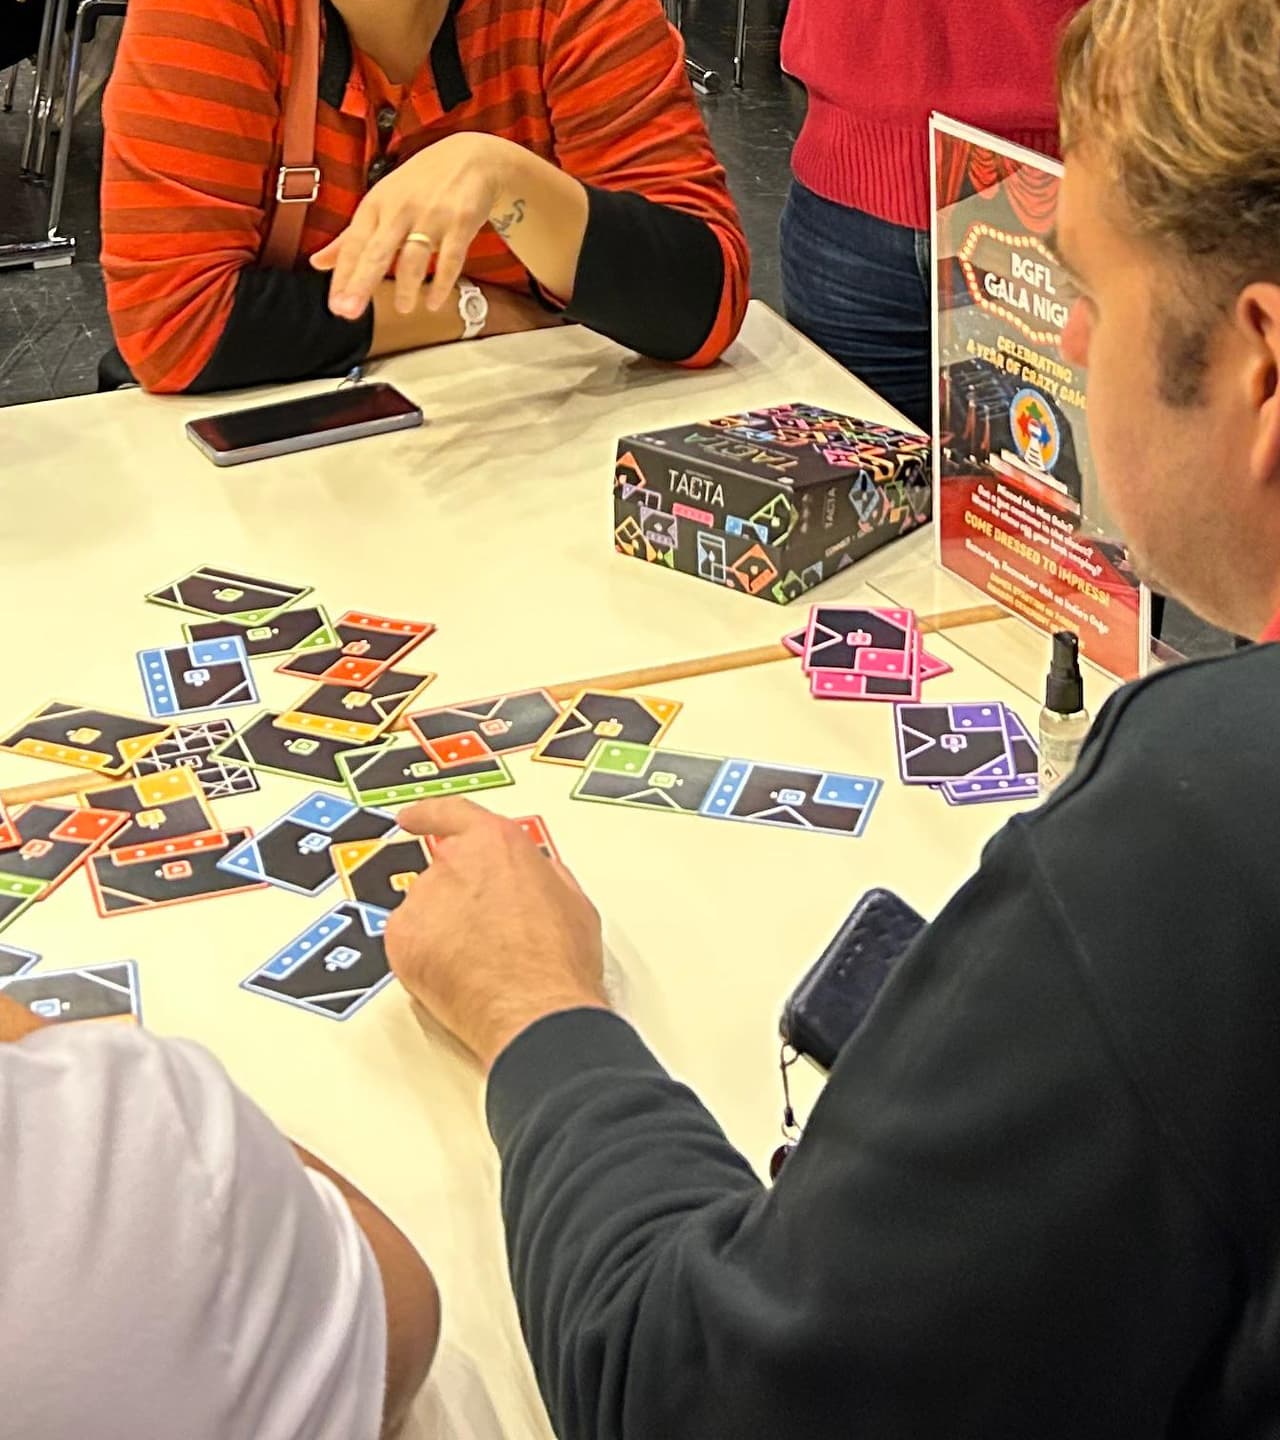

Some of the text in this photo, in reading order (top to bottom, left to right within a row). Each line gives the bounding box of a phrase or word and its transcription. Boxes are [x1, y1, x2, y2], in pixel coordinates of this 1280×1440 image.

[1011, 252, 1056, 295] BGFL
[984, 272, 1069, 329] GALA NIG
[966, 338, 976, 354] A
[976, 342, 1004, 369] YEAR
[1005, 357, 1022, 375] OF
[1021, 364, 1059, 397] CRAZY
[997, 335, 1073, 384] CELEBRATING
[667, 468, 726, 508] TACTA
[964, 510, 992, 537] COME
[994, 527, 1041, 566] DRESSED
[1043, 556, 1058, 575] TO
[1058, 564, 1111, 607] IMPRESS!
